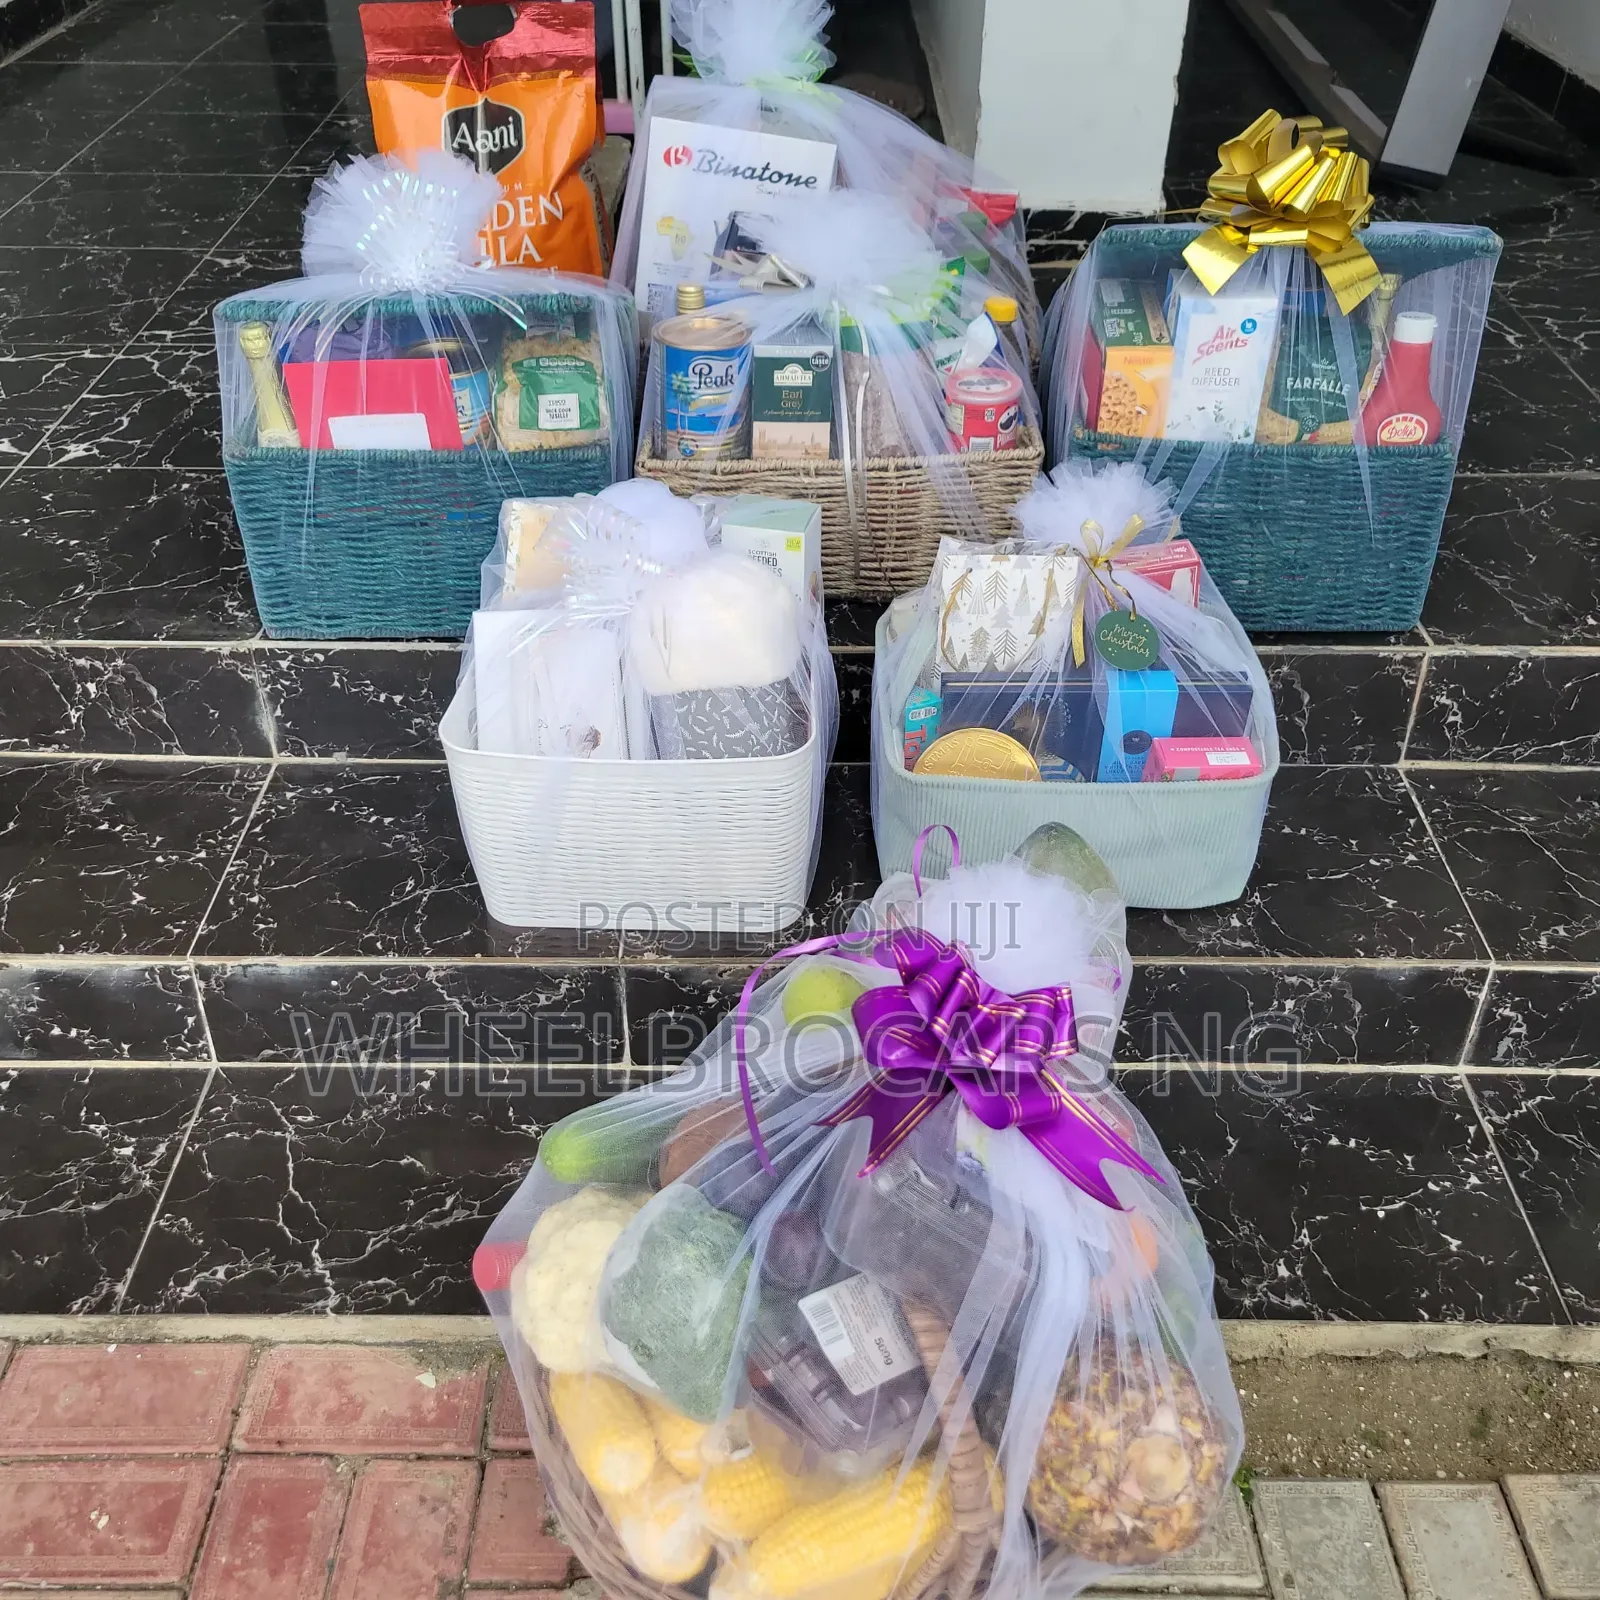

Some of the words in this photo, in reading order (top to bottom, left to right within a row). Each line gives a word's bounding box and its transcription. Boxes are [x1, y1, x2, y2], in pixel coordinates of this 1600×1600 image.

[452, 116, 518, 153] Aani
[693, 149, 818, 190] Binatone
[482, 191, 564, 231] DEN
[1212, 325, 1237, 344] Air
[1192, 336, 1249, 366] Scents
[692, 362, 735, 390] Peak
[1191, 377, 1240, 387] DIFFUSER
[1204, 367, 1231, 377] REED
[782, 389, 803, 399] Earl
[1286, 376, 1351, 396] FARFALLE
[781, 400, 803, 410] Grey
[748, 549, 777, 557] SCOTTISH
[1100, 629, 1150, 658] Christmas
[1113, 623, 1147, 646] Merry
[873, 1337, 894, 1366] 500g
